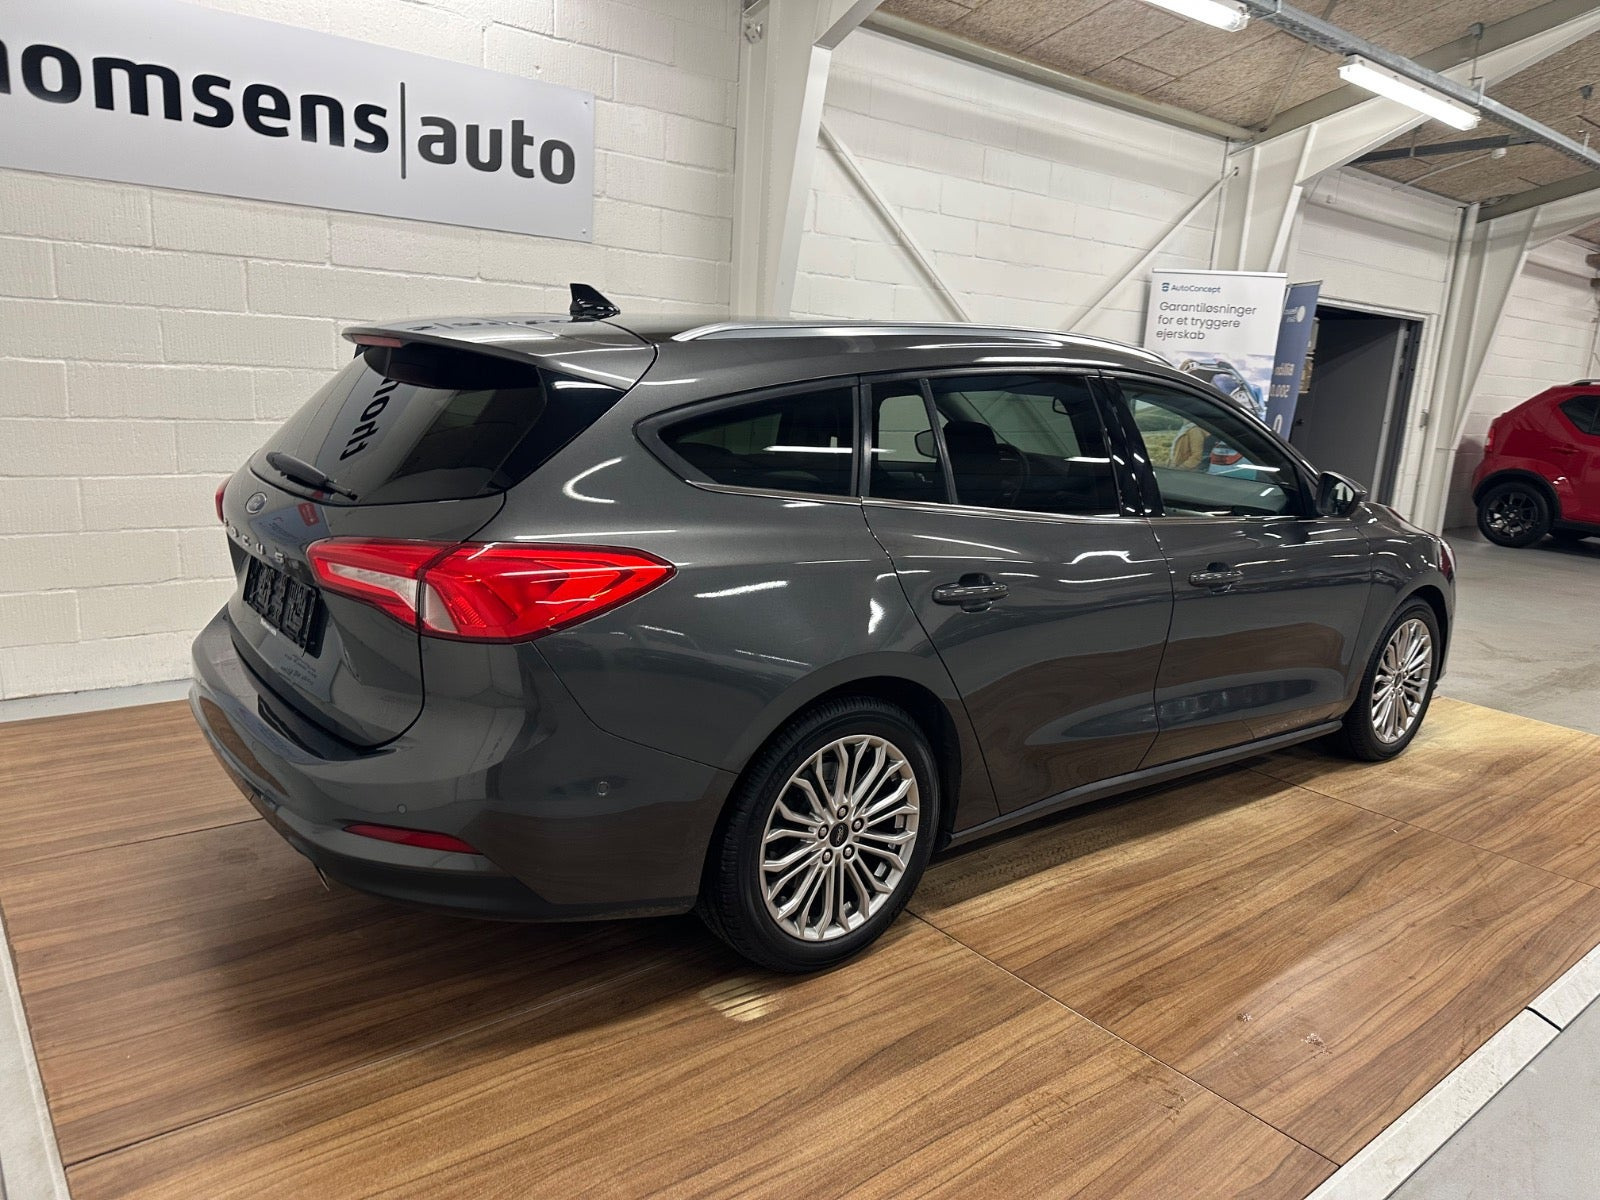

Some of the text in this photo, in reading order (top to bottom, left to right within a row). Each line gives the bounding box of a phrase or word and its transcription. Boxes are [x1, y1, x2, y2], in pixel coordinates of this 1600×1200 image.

[417, 115, 575, 185] auto
[1171, 284, 1221, 293] AutoConcept
[1160, 301, 1257, 317] Garantiløsninger
[1158, 314, 1240, 330] for et tryggere
[1156, 329, 1205, 340] ejerskab
